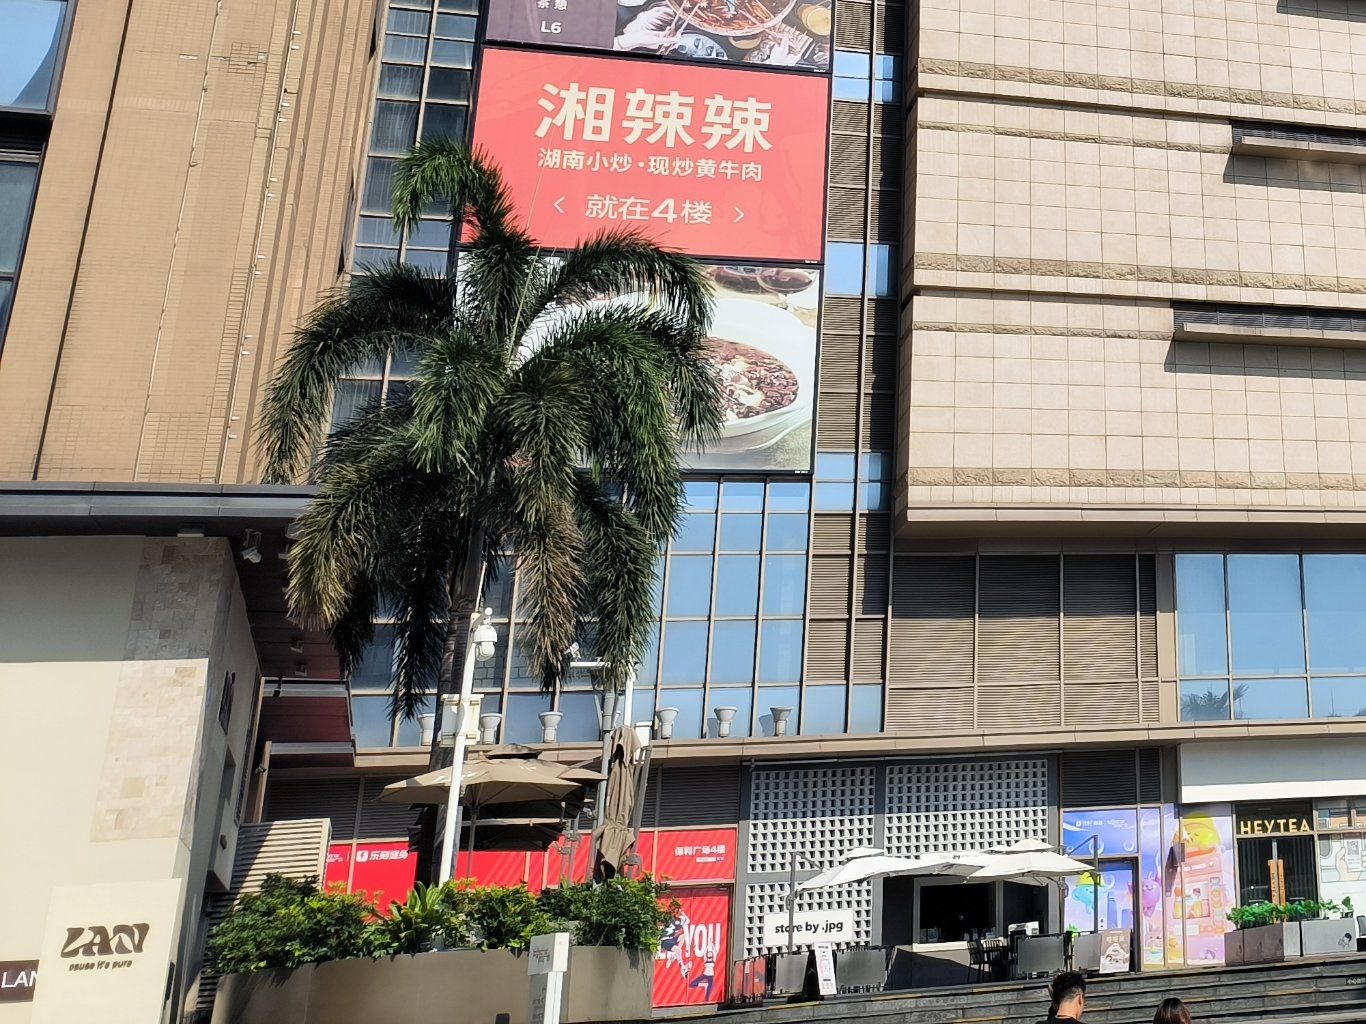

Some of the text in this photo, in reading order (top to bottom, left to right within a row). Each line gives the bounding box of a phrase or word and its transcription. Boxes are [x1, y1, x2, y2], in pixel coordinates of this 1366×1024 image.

[541, 21, 562, 34] L6
[534, 82, 773, 154] 湘辣辣
[585, 194, 712, 225] 就在4楼
[1240, 819, 1310, 834] HEYTEA
[61, 923, 149, 958] LAN
[683, 923, 721, 958] YOU
[805, 921, 819, 933] by
[822, 920, 843, 932] .jpg
